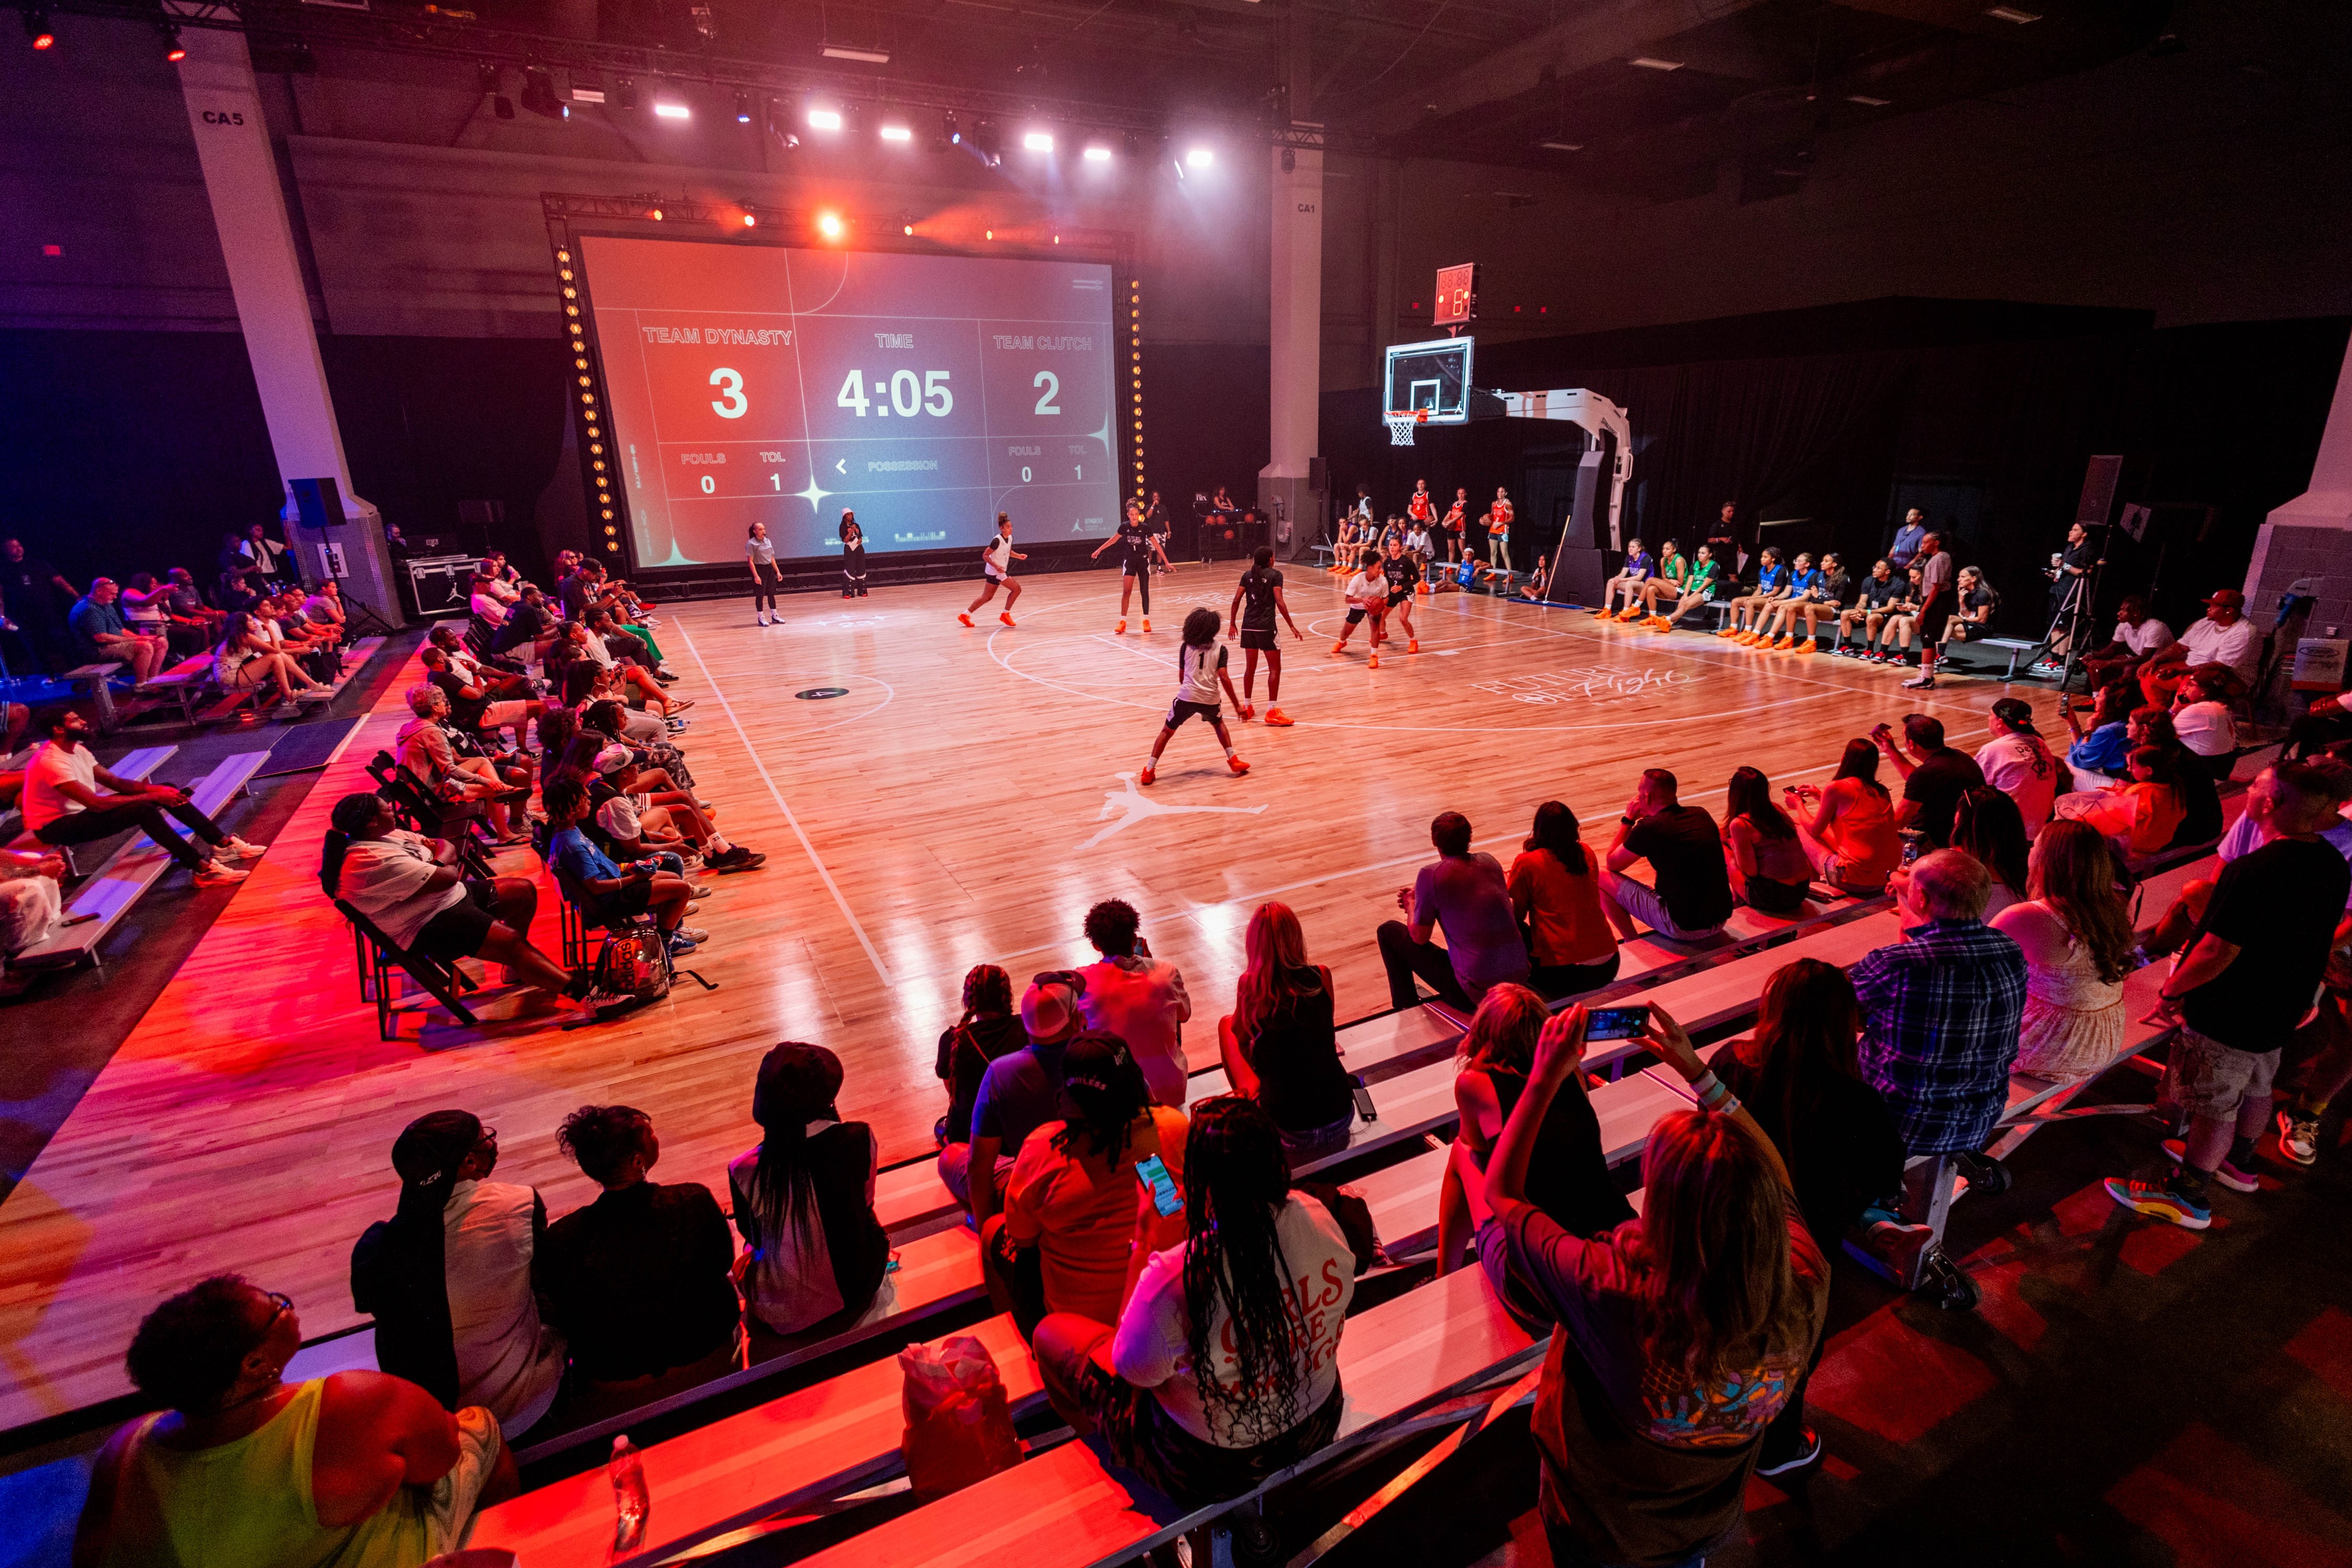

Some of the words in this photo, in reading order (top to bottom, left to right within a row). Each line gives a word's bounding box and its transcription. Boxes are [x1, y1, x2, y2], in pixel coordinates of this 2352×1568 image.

[203, 111, 244, 126] CA5
[1298, 203, 1314, 213] CA1
[643, 327, 700, 344] TEAM
[704, 328, 792, 345] DYNASTY
[875, 333, 914, 349] TIME
[993, 335, 1034, 350] TEAM
[1037, 336, 1091, 350] CLUTCH
[709, 368, 748, 419] 3
[837, 369, 953, 418] 4:05
[1033, 371, 1061, 415] 2
[681, 453, 726, 464] FOULS
[760, 452, 786, 463] TOL
[1009, 445, 1041, 456] FOULS
[868, 460, 938, 472] POSSESSION
[1022, 466, 1032, 483] 0
[1074, 464, 1082, 480] 1
[701, 475, 715, 494] 0
[770, 473, 781, 491] 1
[1199, 651, 1205, 669] 1
[1467, 663, 1641, 695] FUTURE
[620, 942, 635, 990] adidas
